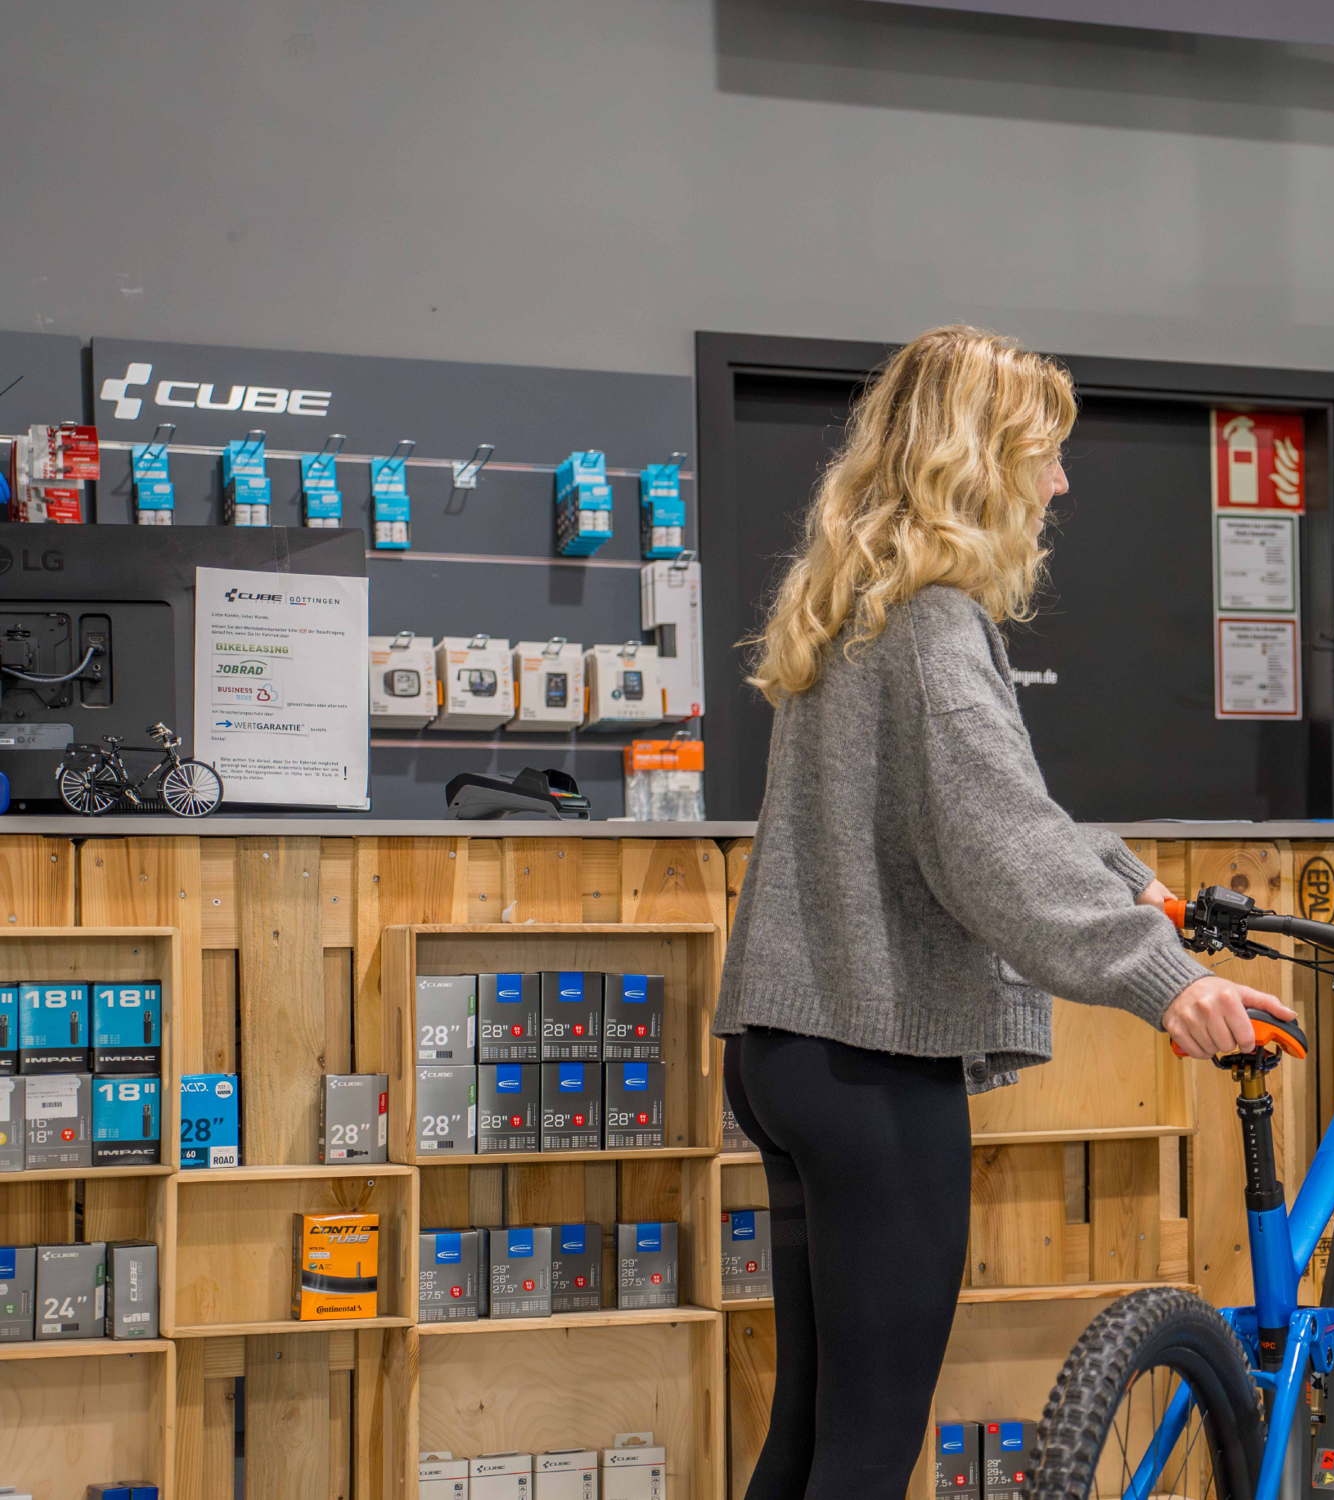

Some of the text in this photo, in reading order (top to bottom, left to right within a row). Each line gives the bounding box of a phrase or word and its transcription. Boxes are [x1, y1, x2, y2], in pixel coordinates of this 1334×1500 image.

[155, 380, 332, 417] CUBE
[22, 550, 64, 571] LG
[238, 592, 340, 605] CUBE GÖTTINGEN
[216, 642, 289, 654] BIKELEASING
[216, 664, 263, 675] JOBRAD
[1012, 668, 1058, 686] ingen.de
[217, 686, 253, 694] BUSINESS
[234, 721, 301, 731] WERTGARANTIE
[1307, 869, 1330, 920] EPAL
[24, 990, 82, 1009] 18"
[99, 990, 156, 1008] 18"
[482, 1025, 508, 1038] 28"
[543, 1024, 570, 1037] 28"
[606, 1024, 632, 1037] 28"
[98, 1083, 155, 1102] 18"
[481, 1116, 507, 1129] 28"
[544, 1114, 570, 1127] 28"
[608, 1113, 634, 1126] 28"
[28, 1130, 53, 1144] 18"
[213, 1156, 234, 1165] ROAD
[310, 1226, 357, 1234] CONTI
[328, 1234, 370, 1244] TUBE
[621, 1259, 638, 1268] 29"
[493, 1265, 509, 1274] 29"
[621, 1269, 638, 1277] 28"
[420, 1271, 437, 1280] 29"
[493, 1274, 509, 1284] 28"
[420, 1281, 437, 1290] 28"
[621, 1278, 646, 1287] 27.5"
[492, 1284, 517, 1294] 27.5"
[420, 1291, 445, 1300] 27.5"
[316, 1305, 356, 1314] Continental
[987, 1468, 1004, 1476] 29+
[987, 1477, 1012, 1485] 27.5+
